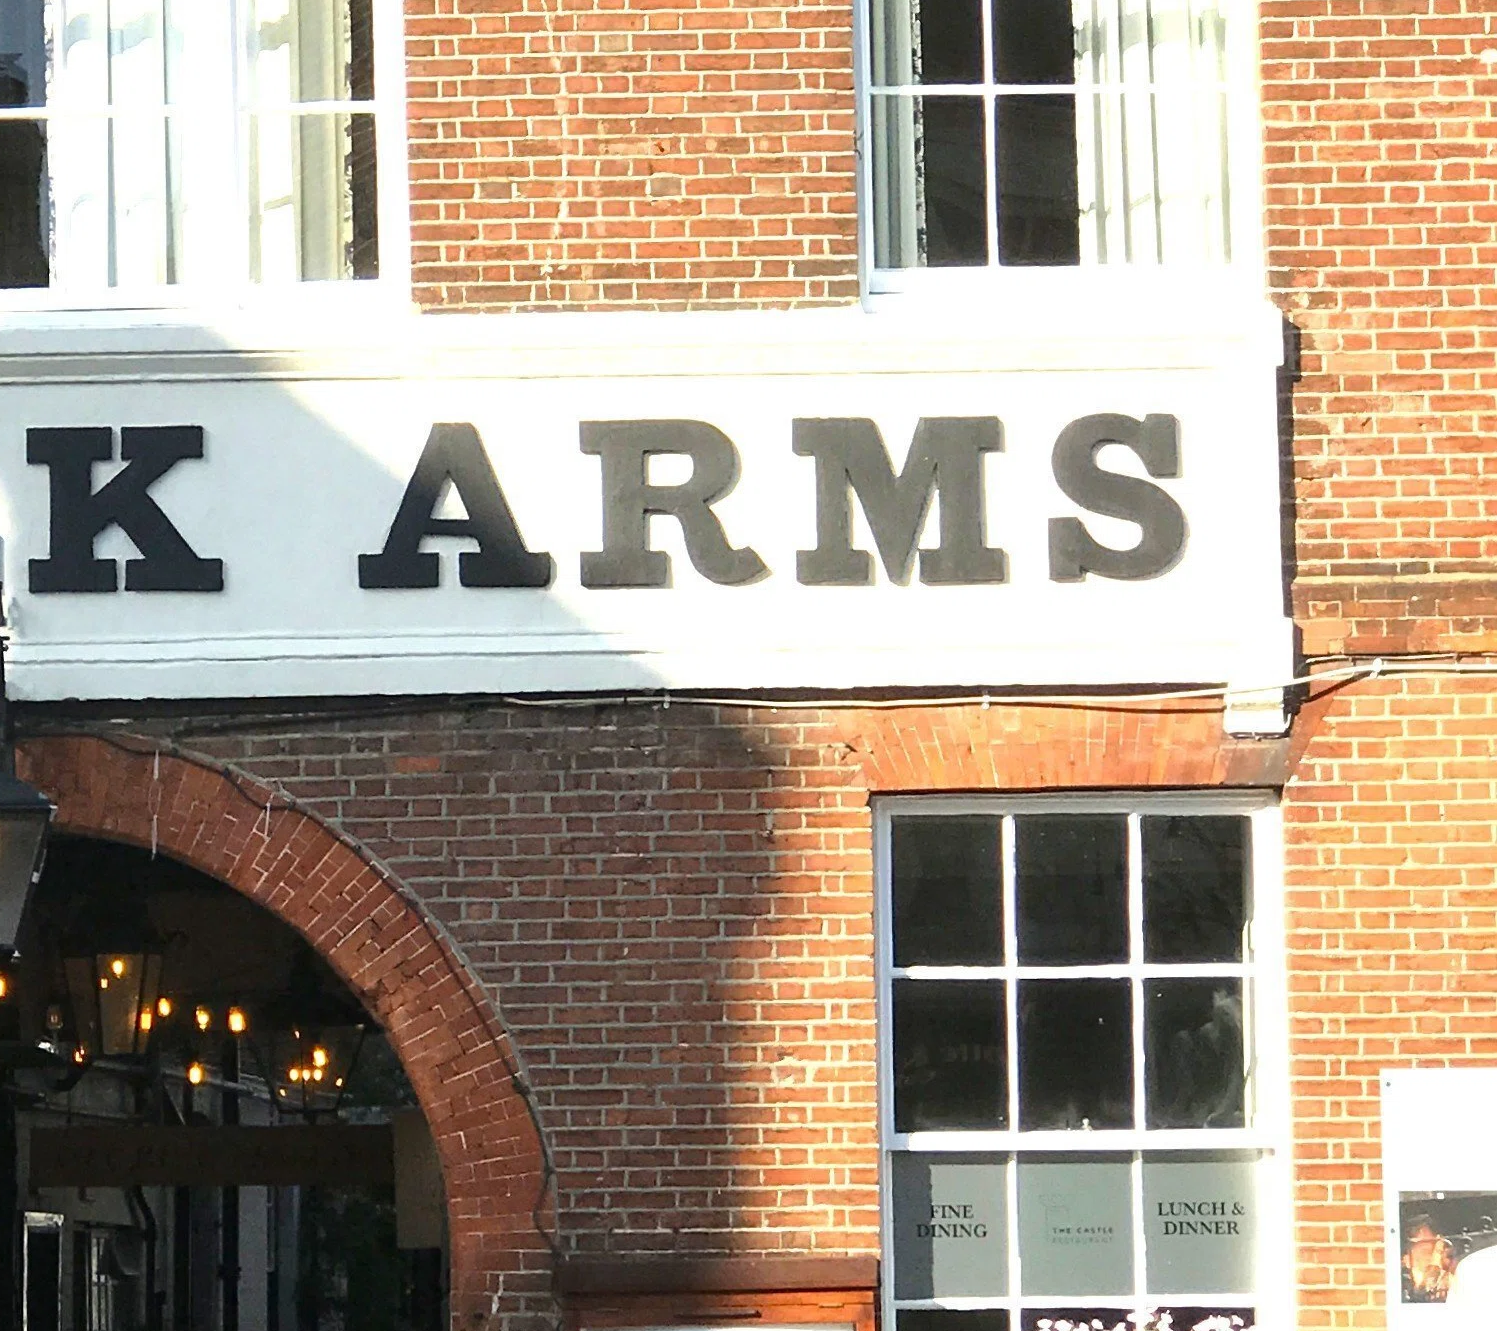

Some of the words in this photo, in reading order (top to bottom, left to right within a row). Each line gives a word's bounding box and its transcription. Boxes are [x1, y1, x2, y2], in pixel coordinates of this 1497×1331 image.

[357, 412, 1190, 589] ARMS
[930, 1204, 975, 1220] FINE
[1157, 1201, 1225, 1217] LUNCH
[1232, 1202, 1246, 1217] &
[916, 1223, 988, 1239] DINING
[1052, 1226, 1071, 1235] THE
[1076, 1226, 1113, 1235] CASTLE
[1163, 1220, 1240, 1236] DINNER
